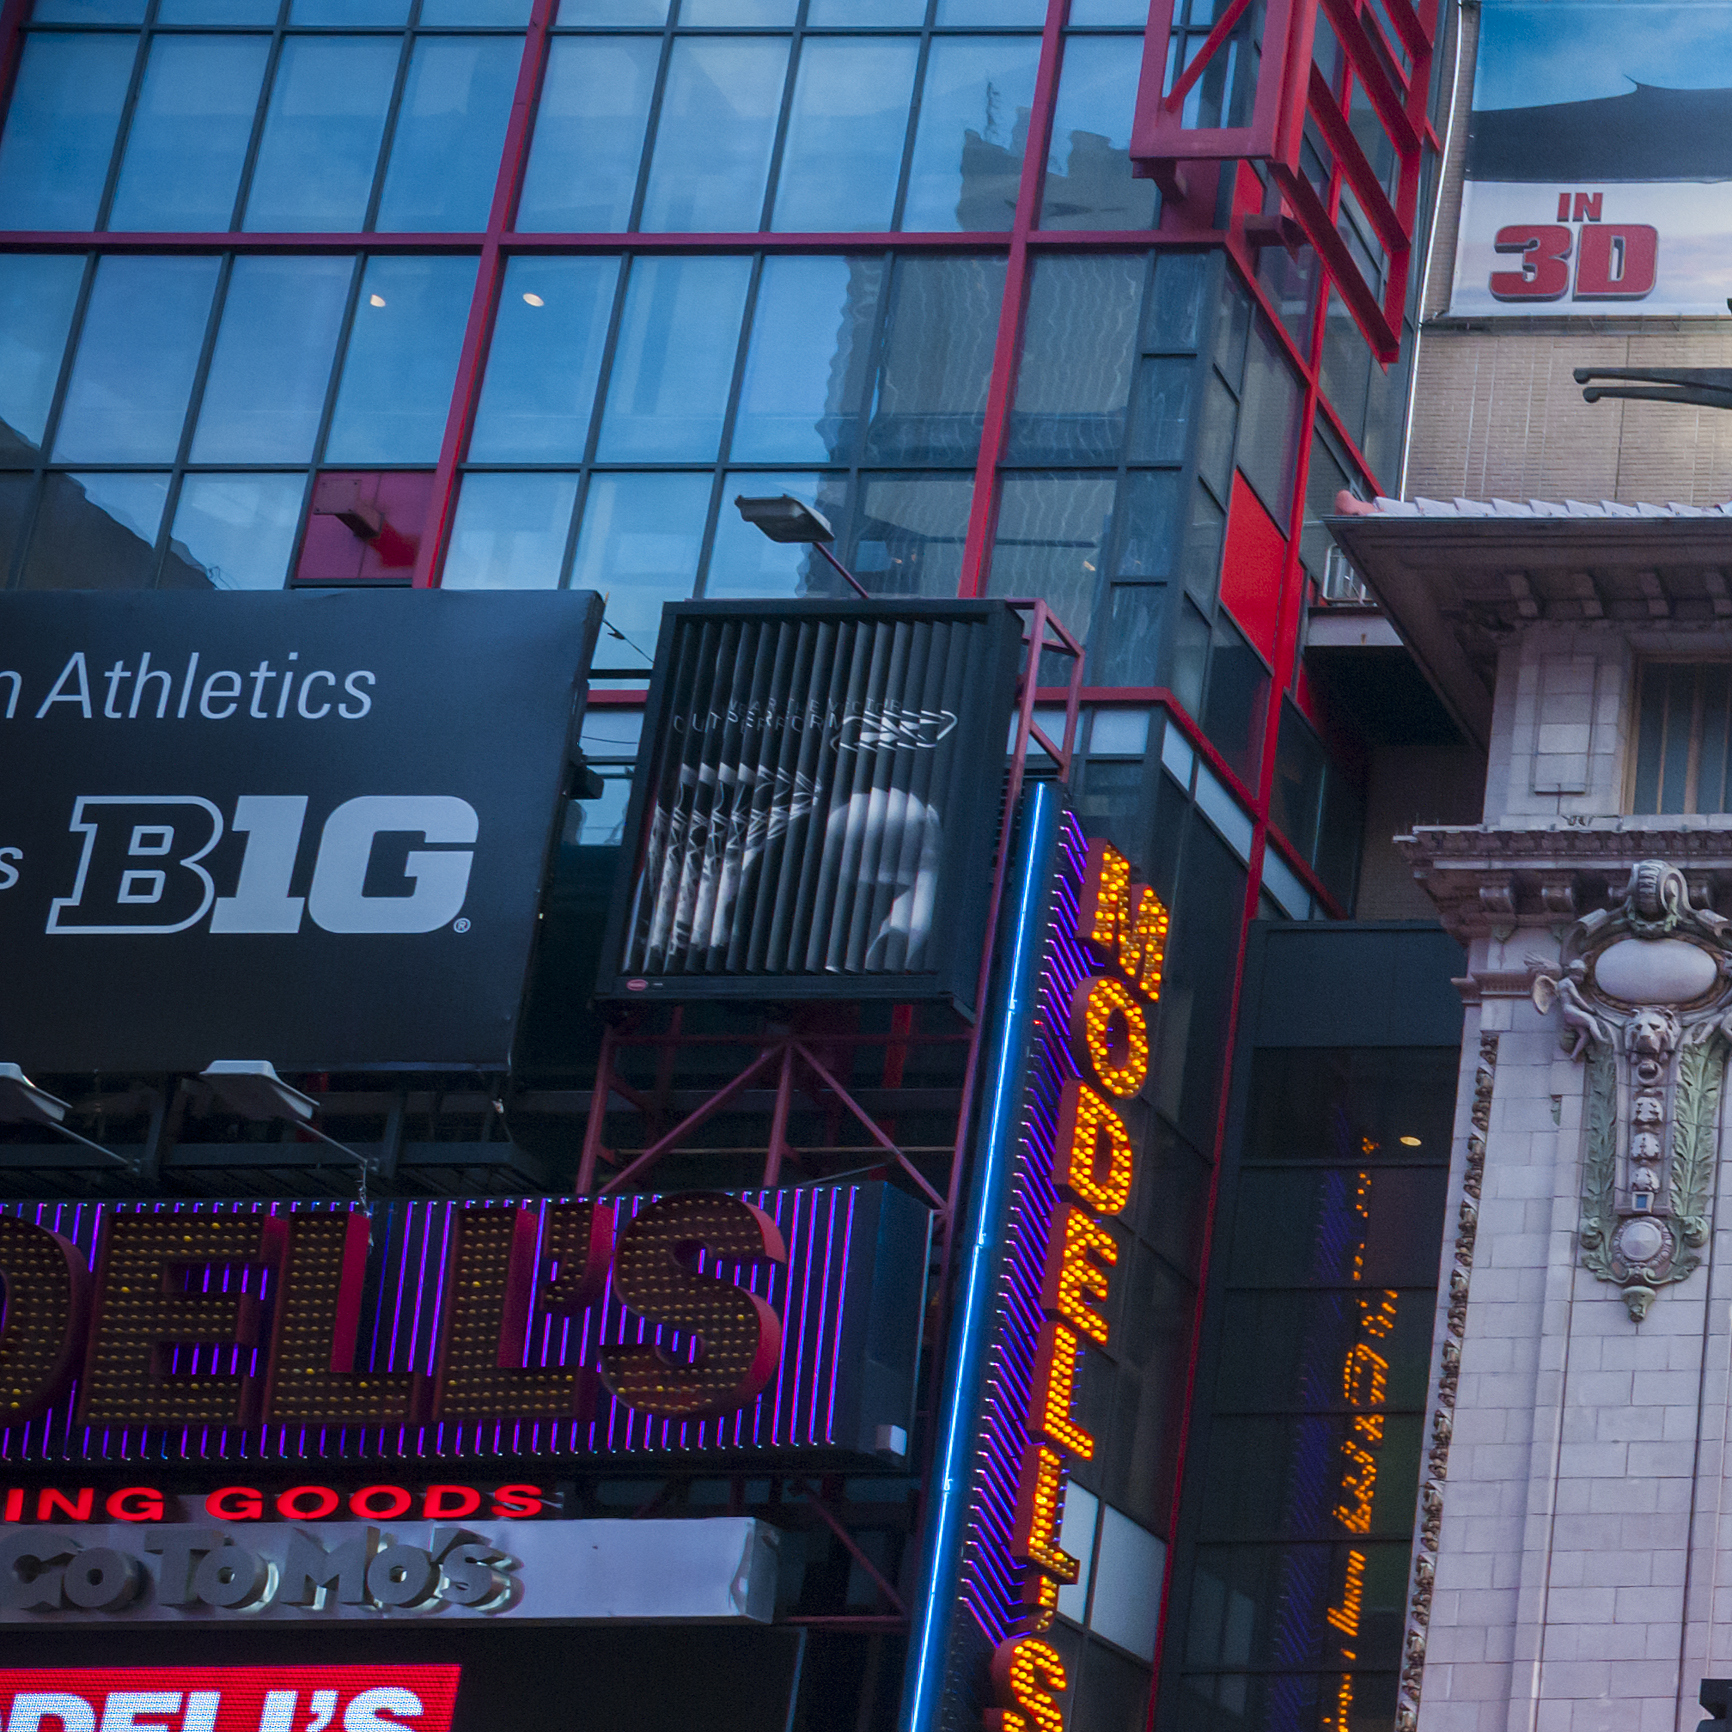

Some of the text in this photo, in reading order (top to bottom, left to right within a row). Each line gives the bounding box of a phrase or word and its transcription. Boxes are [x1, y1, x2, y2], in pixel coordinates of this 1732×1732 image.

[1557, 192, 1602, 223] IN
[1487, 222, 1659, 302] 3D
[36, 650, 376, 721] Athletics
[204, 1483, 546, 1521] GOODS
